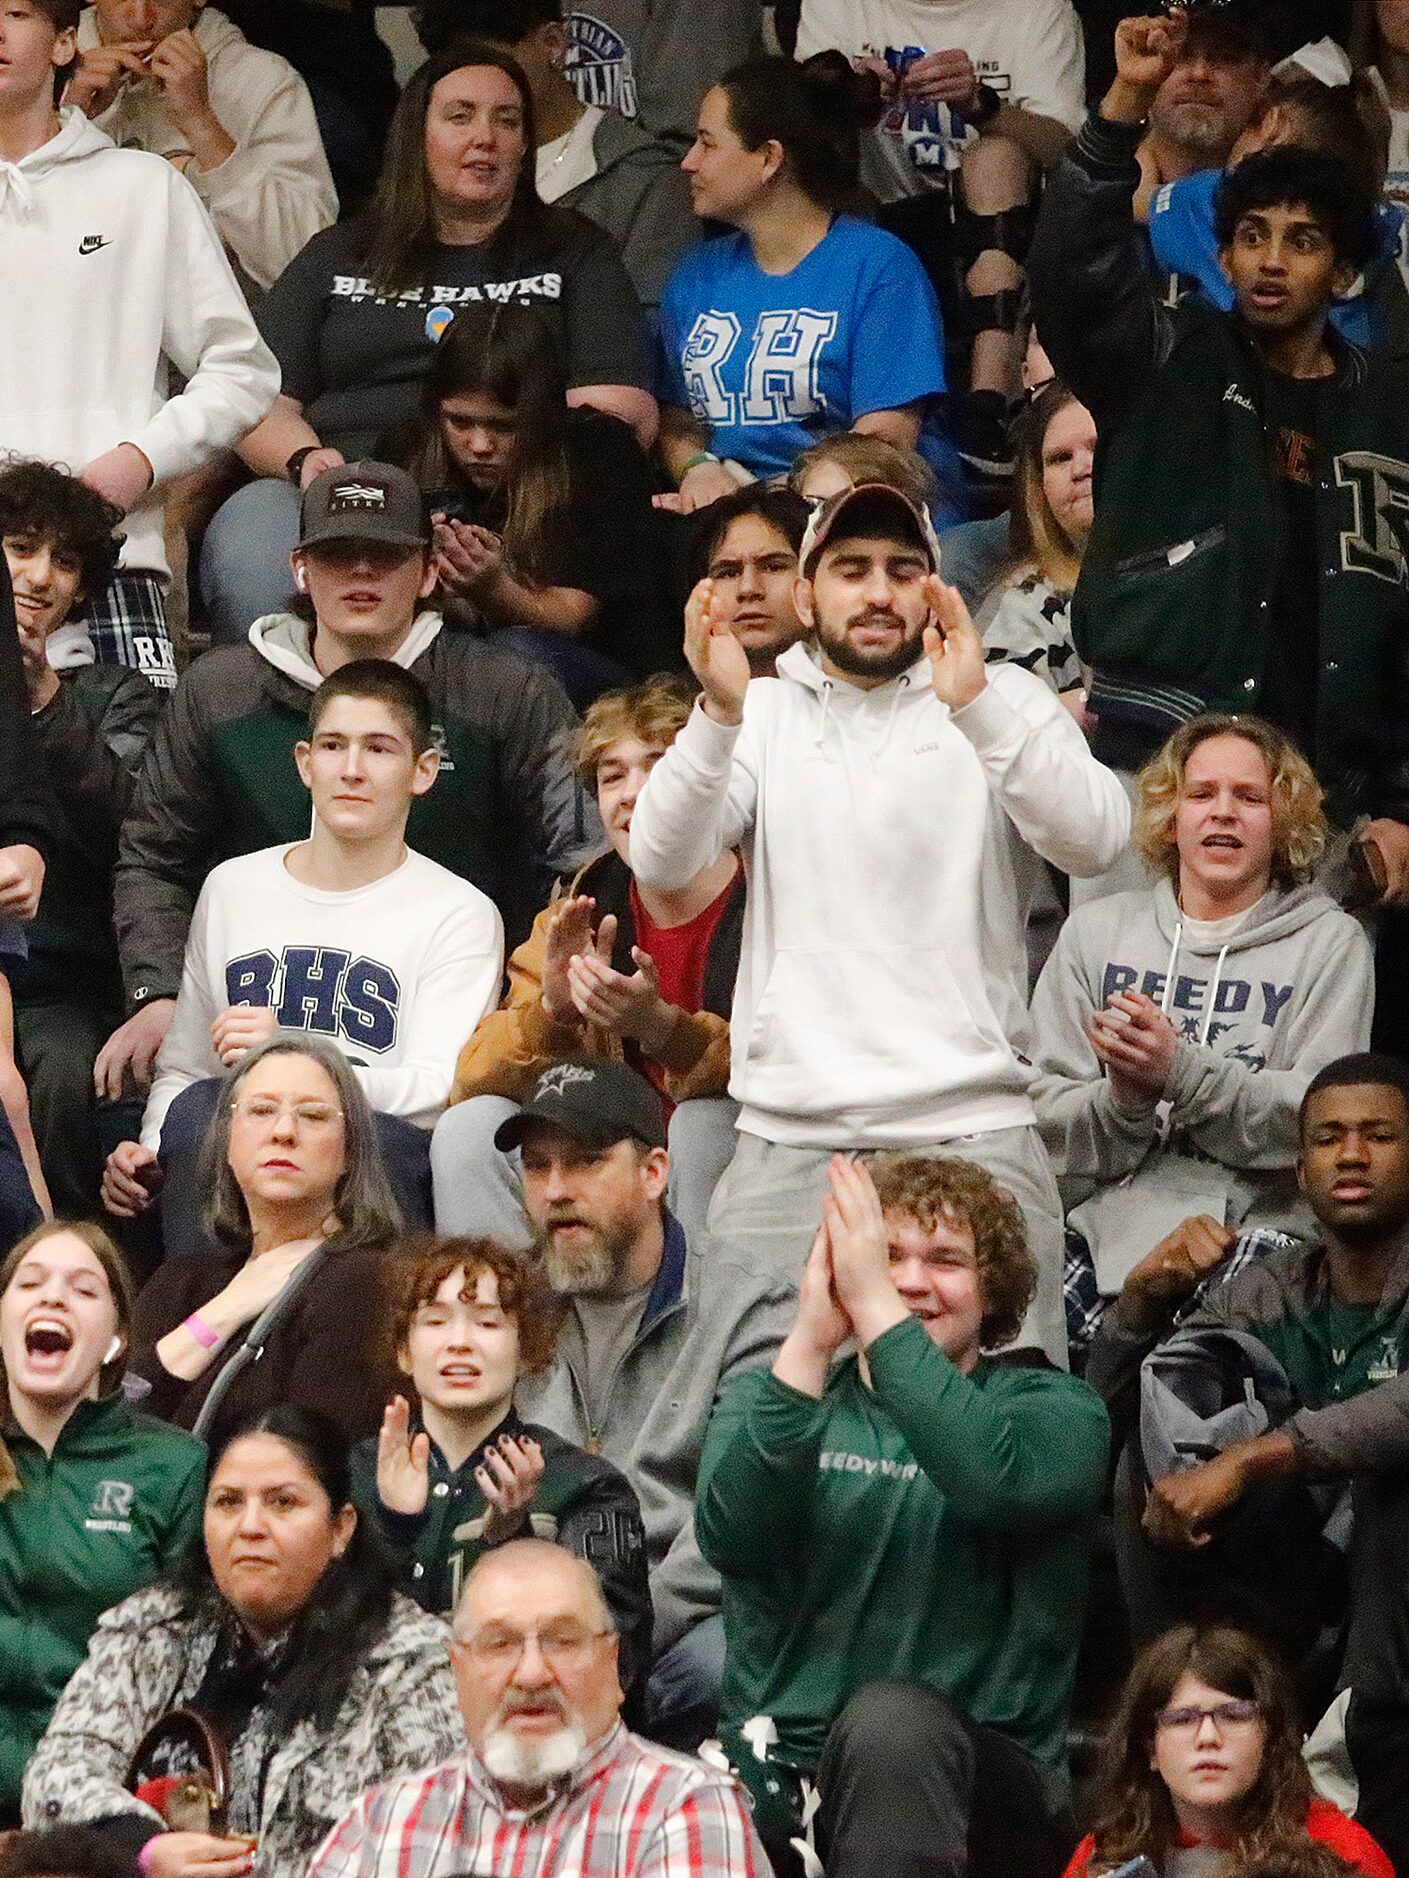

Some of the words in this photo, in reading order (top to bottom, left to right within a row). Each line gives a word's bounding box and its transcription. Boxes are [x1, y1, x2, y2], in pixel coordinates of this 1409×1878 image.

[83, 235, 103, 246] NIKE
[429, 272, 563, 304] HAWKS
[681, 307, 839, 426] RH
[225, 944, 402, 1056] RHS
[1101, 961, 1295, 1028] REEDY
[818, 1451, 879, 1475] EEDY
[92, 1480, 134, 1516] R
